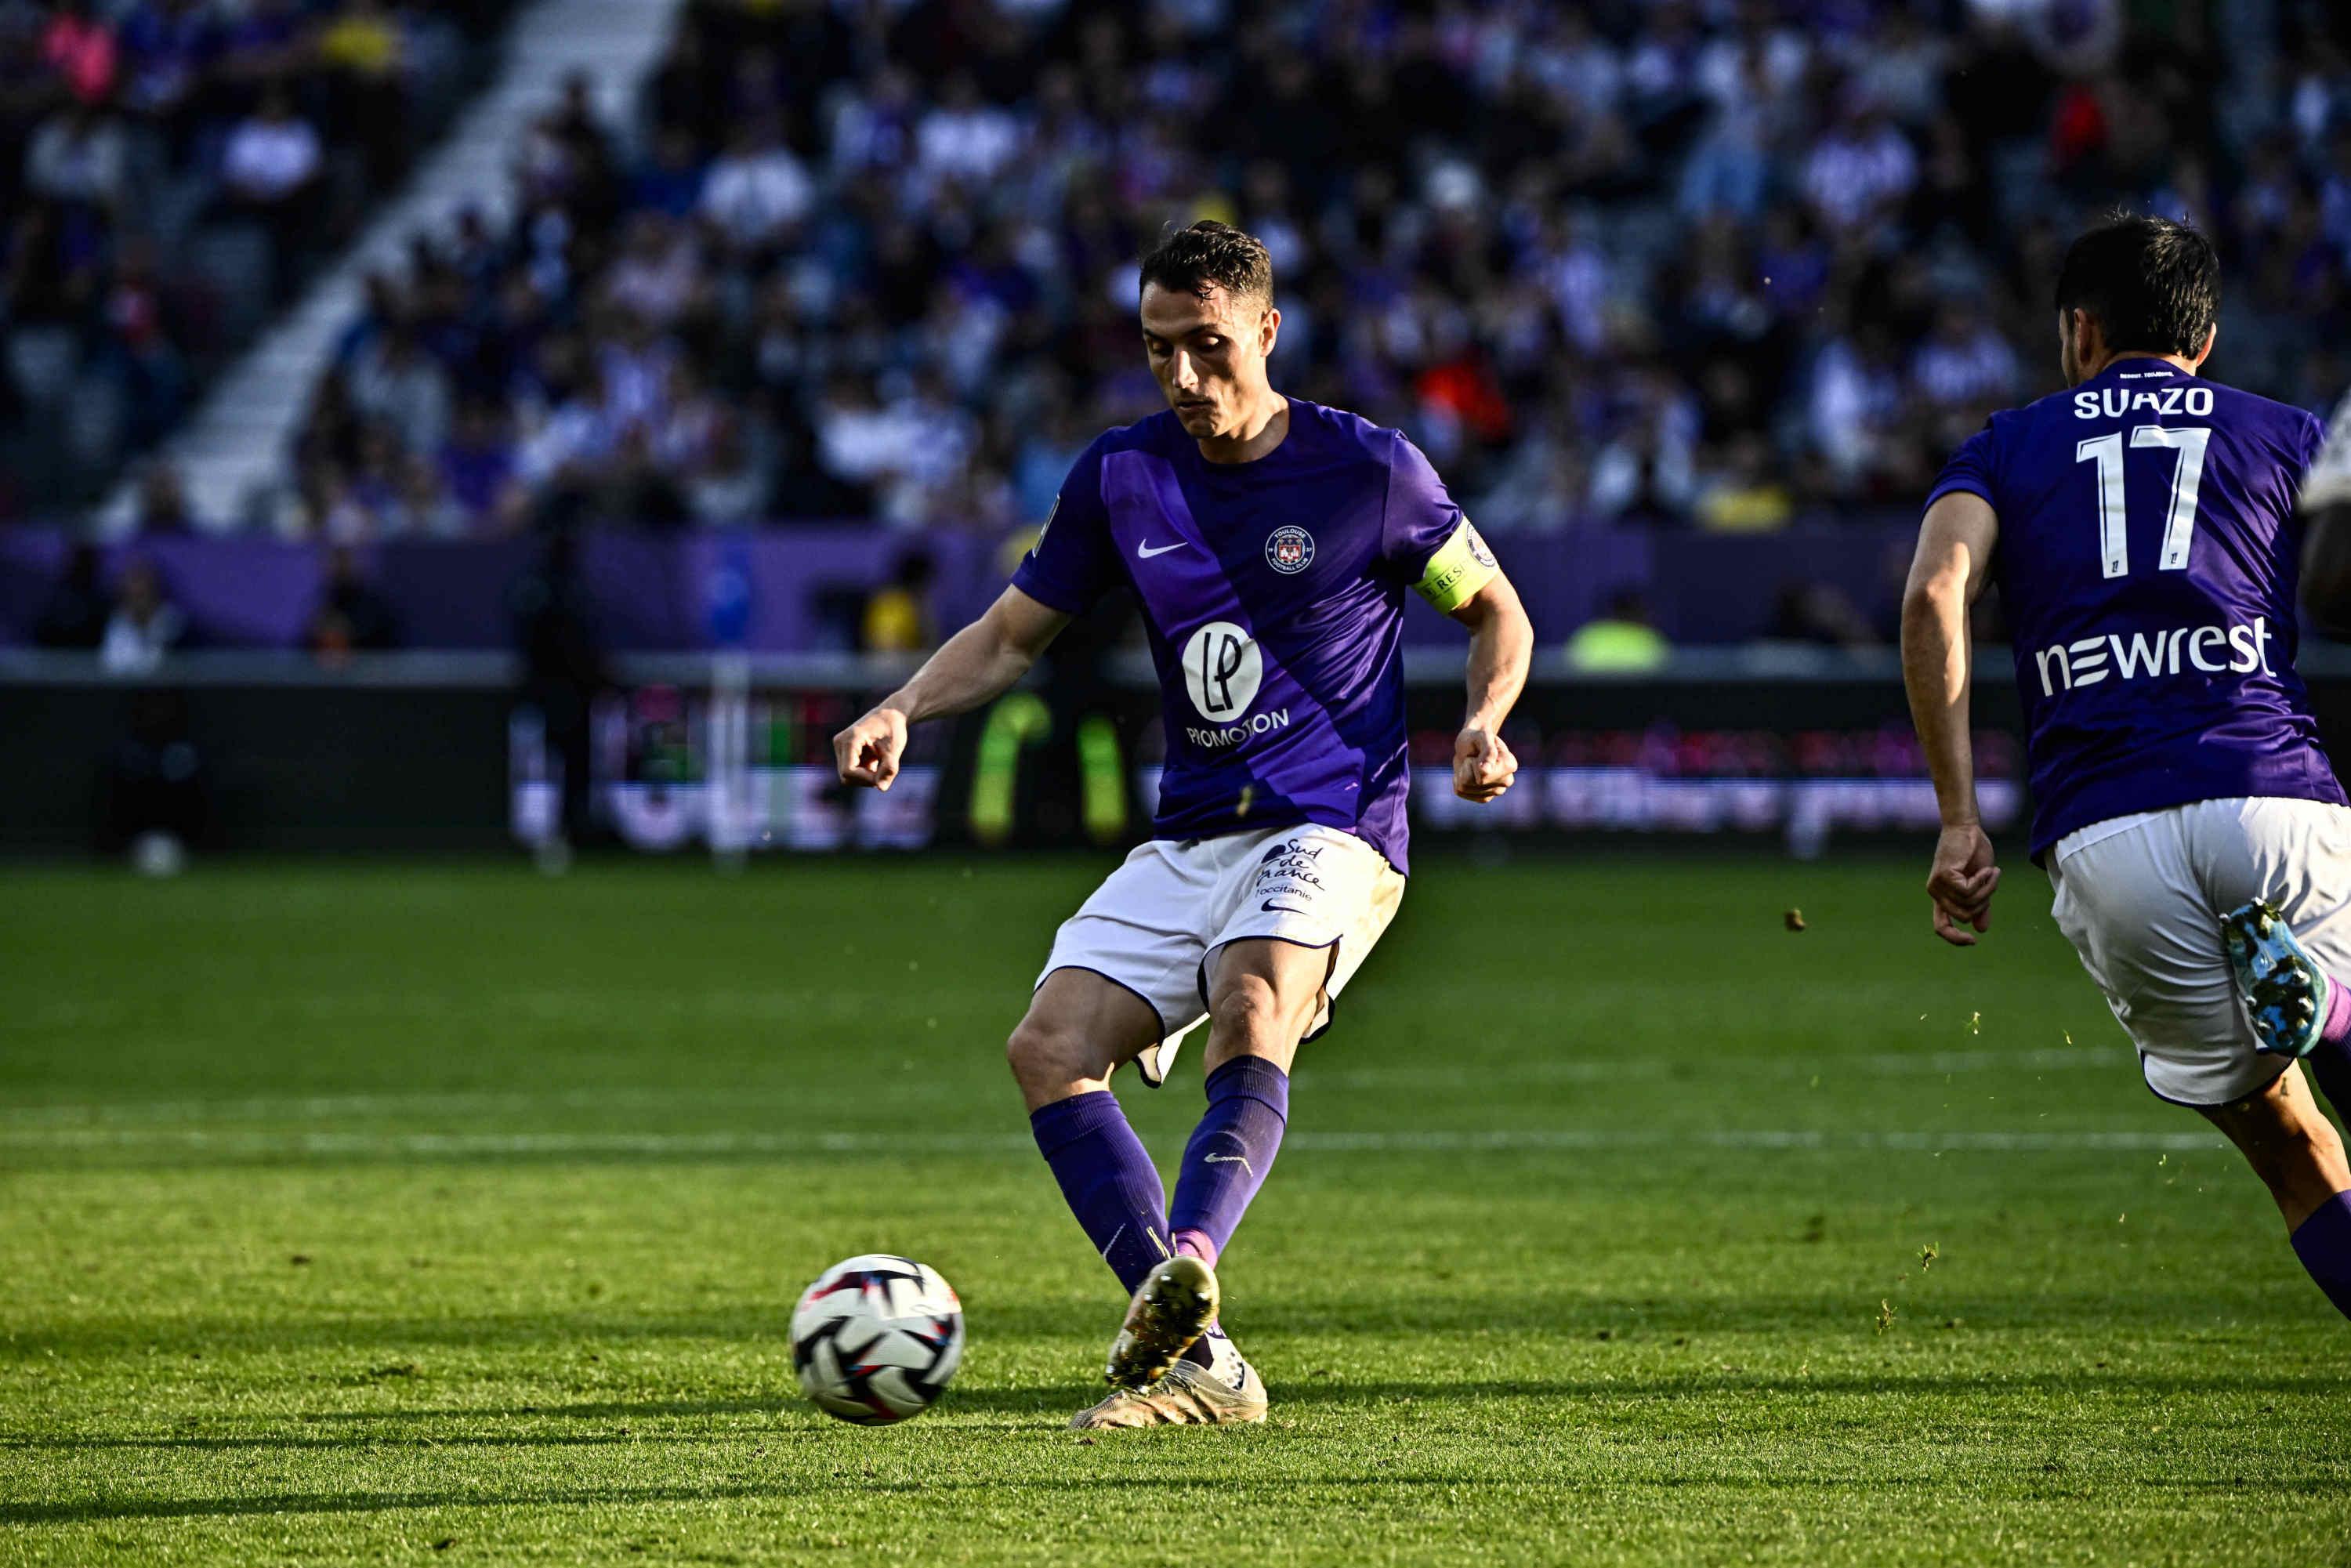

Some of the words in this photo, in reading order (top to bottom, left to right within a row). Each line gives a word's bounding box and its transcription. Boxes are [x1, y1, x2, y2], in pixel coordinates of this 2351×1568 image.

[2074, 388, 2214, 419] SUAZO
[2075, 424, 2212, 579] 17
[1274, 528, 1306, 538] TOULOUSE
[1272, 558, 1295, 570] FOOTBALL
[1295, 557, 1309, 569] CLUB
[1285, 838, 1324, 860] Sud
[1279, 854, 1310, 870] de
